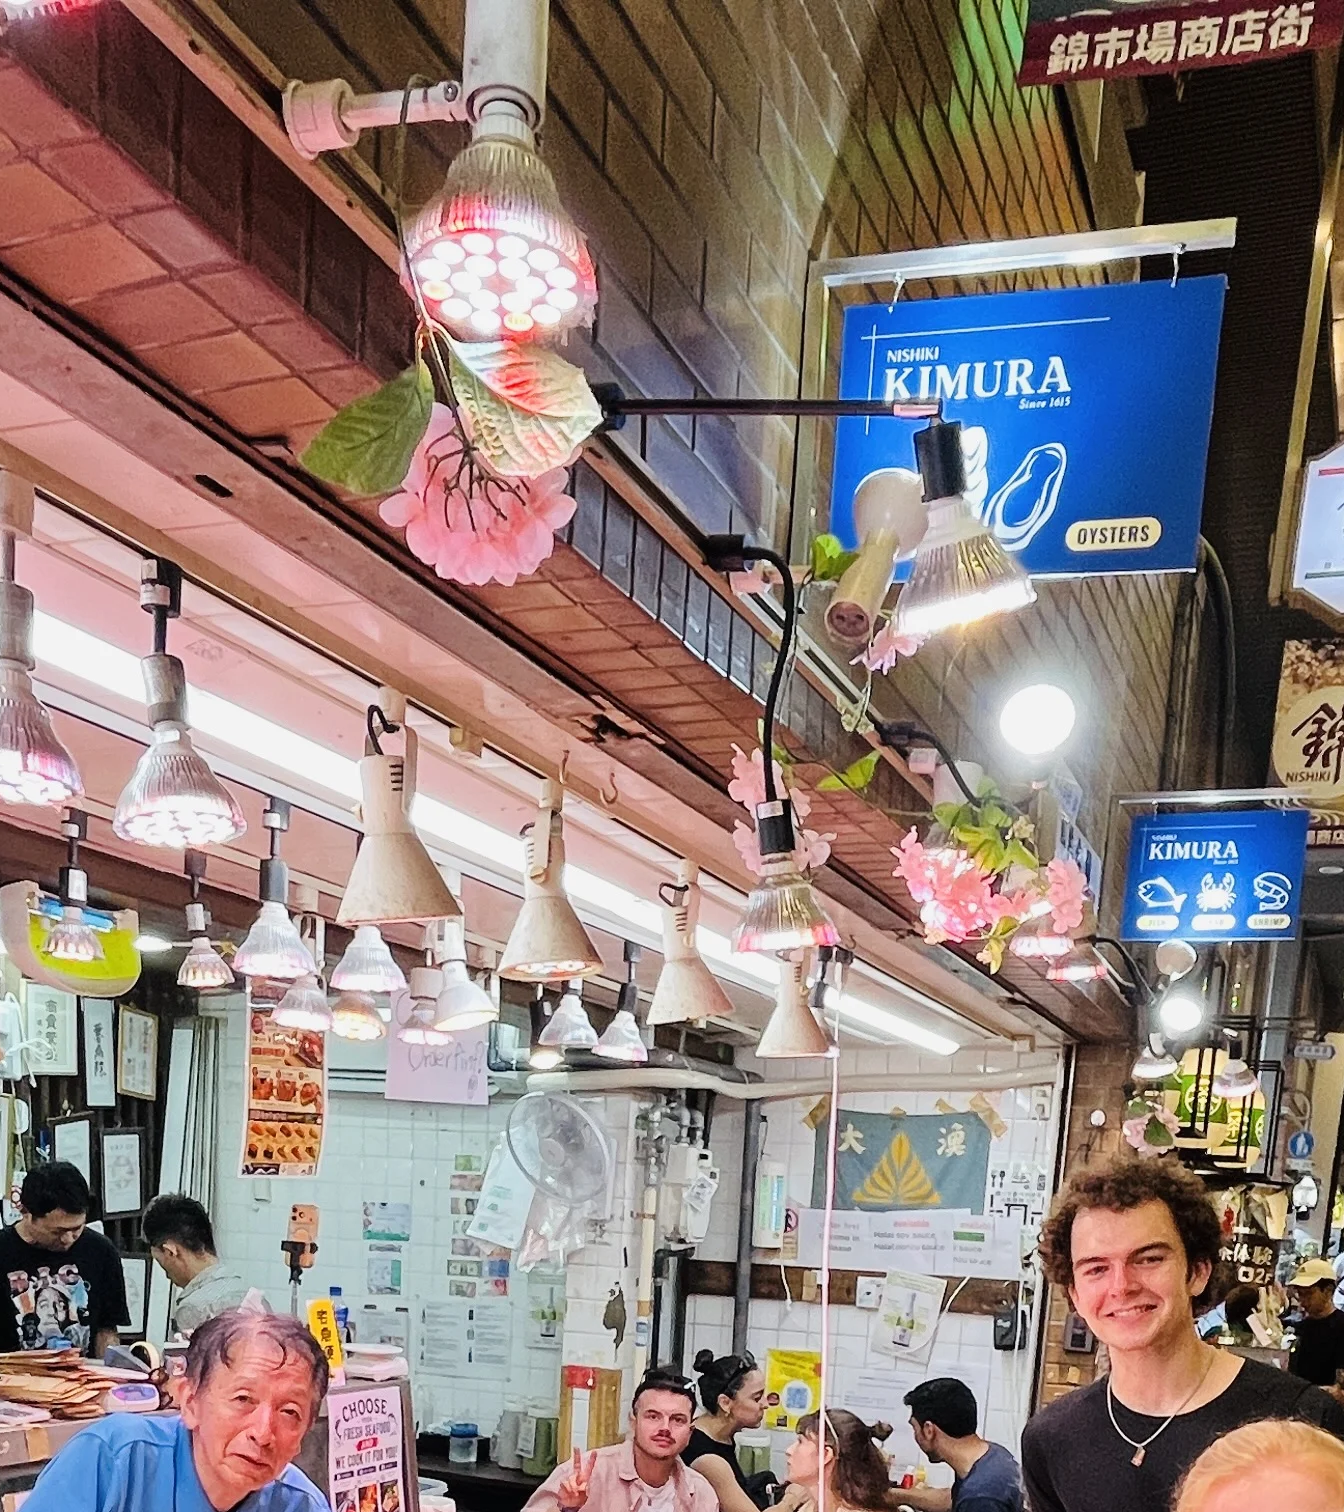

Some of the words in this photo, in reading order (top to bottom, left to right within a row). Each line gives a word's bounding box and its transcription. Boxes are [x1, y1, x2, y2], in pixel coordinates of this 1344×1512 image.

[1046, 1, 1316, 76] 錦市場商店街
[886, 346, 940, 363] NISHIKI
[884, 355, 1072, 401] KIMURA
[1077, 524, 1150, 546] OYSTERS
[1285, 770, 1331, 784] NISHIKI
[1148, 840, 1239, 861] KIMURA
[342, 1397, 388, 1423] CHOOSE
